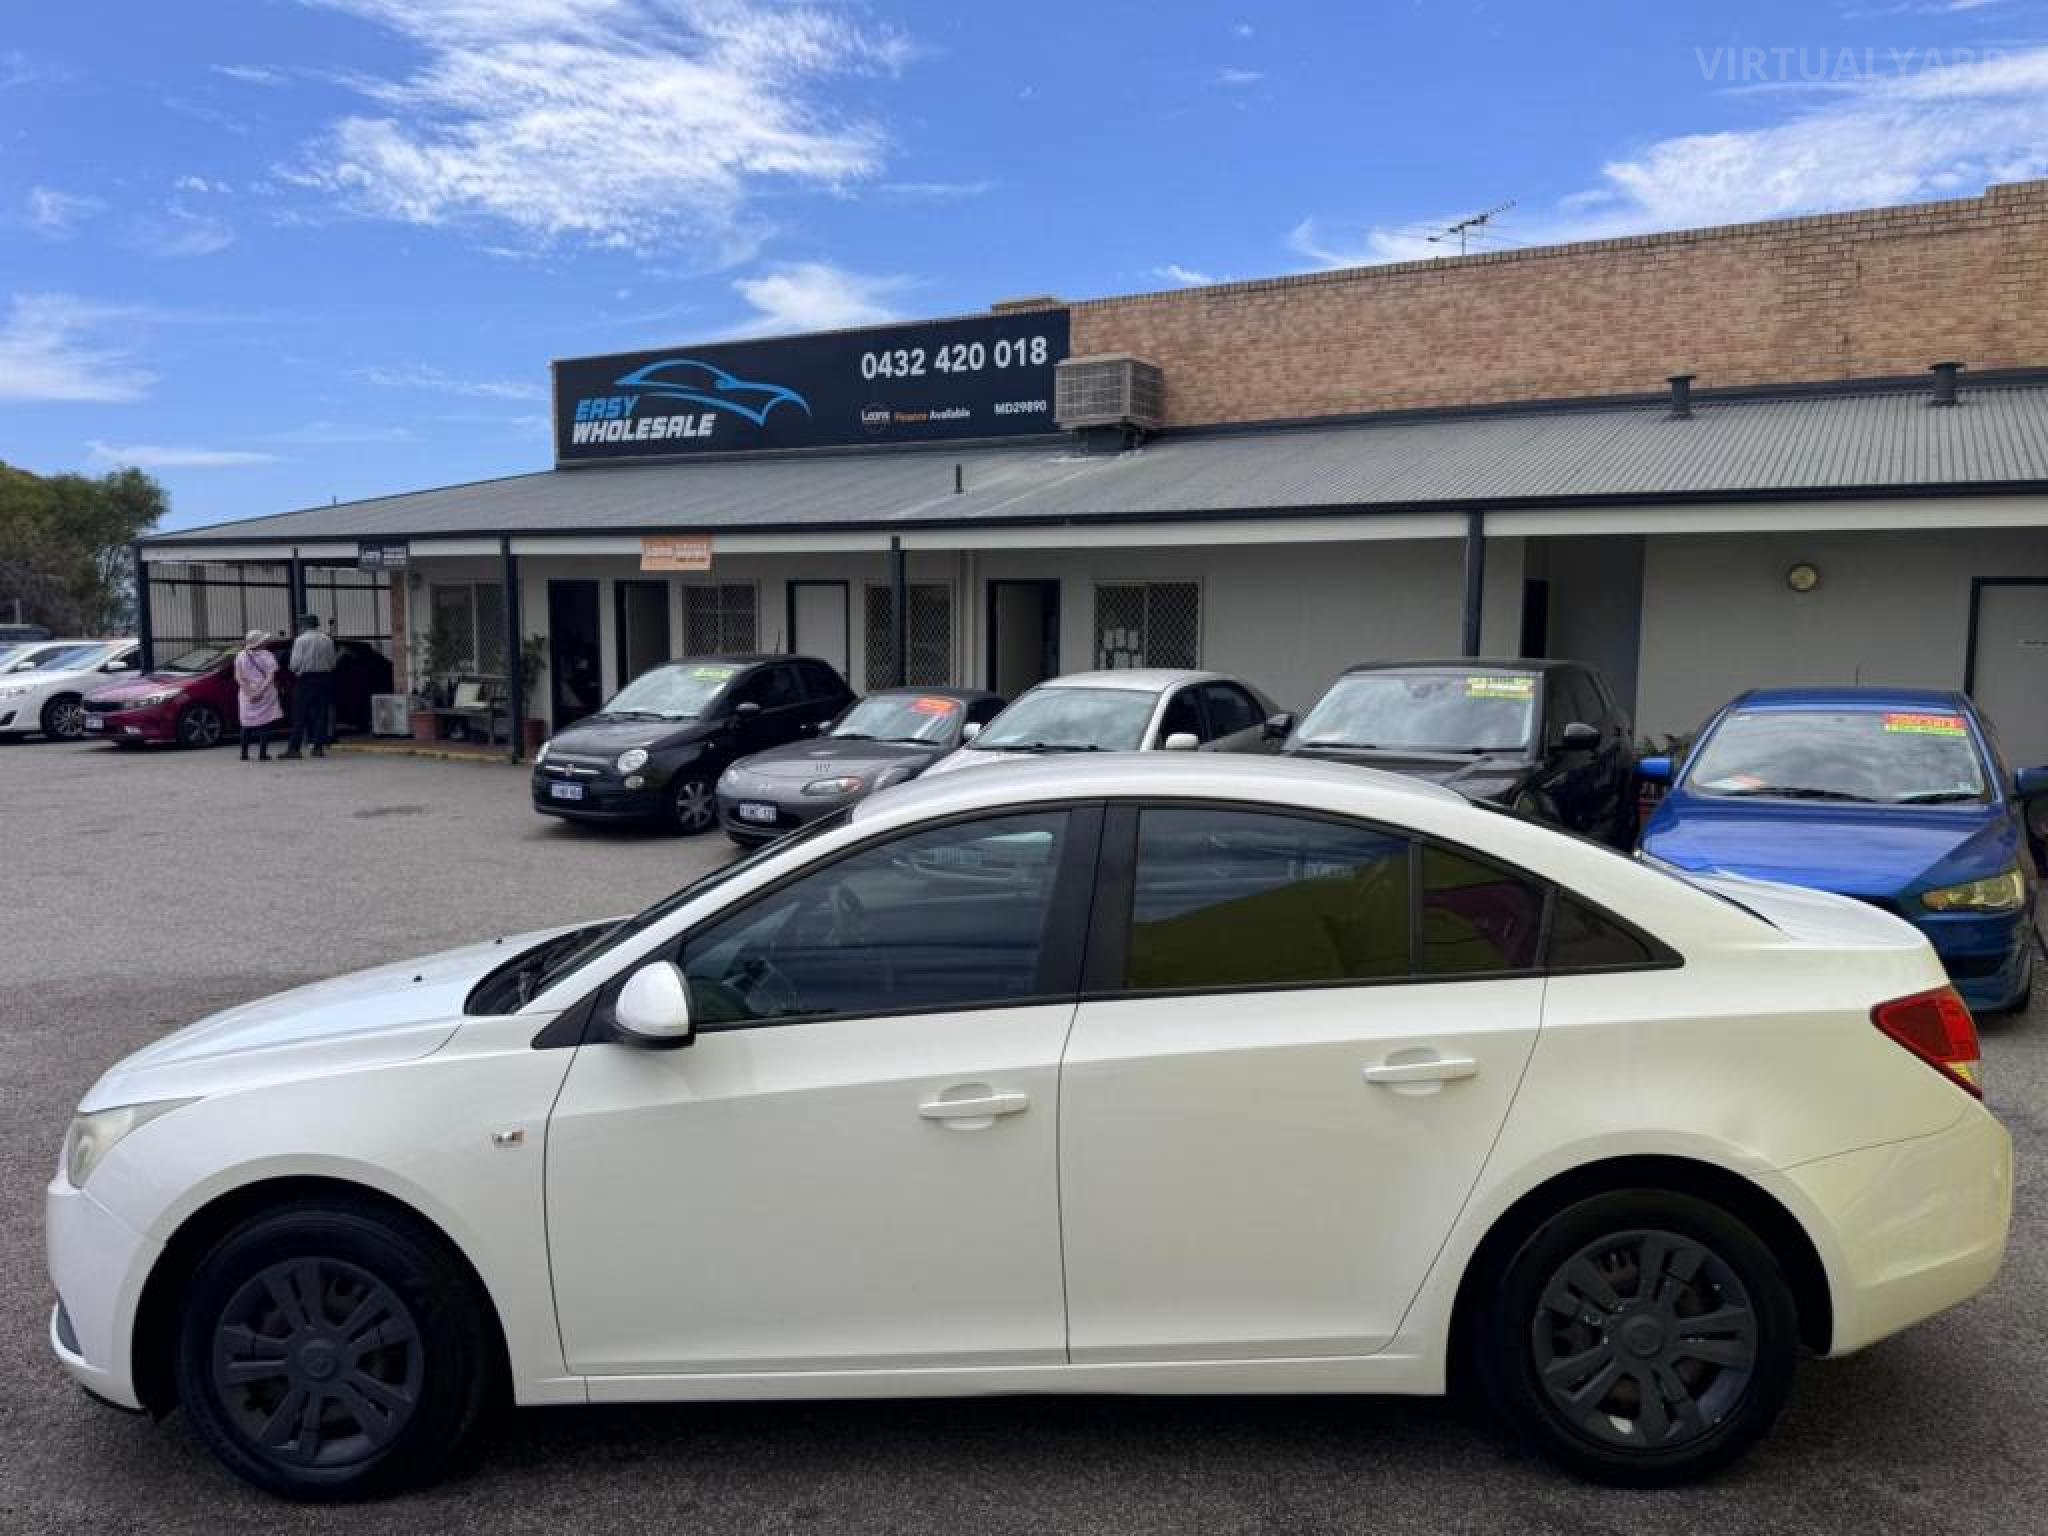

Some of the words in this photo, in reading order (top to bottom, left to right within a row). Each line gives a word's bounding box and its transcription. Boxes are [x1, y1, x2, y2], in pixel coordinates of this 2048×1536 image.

[861, 347, 926, 379] 0432
[934, 341, 985, 373] 420
[994, 335, 1047, 368] 018
[574, 395, 640, 421] EASY
[571, 414, 718, 445] WHOLESALE
